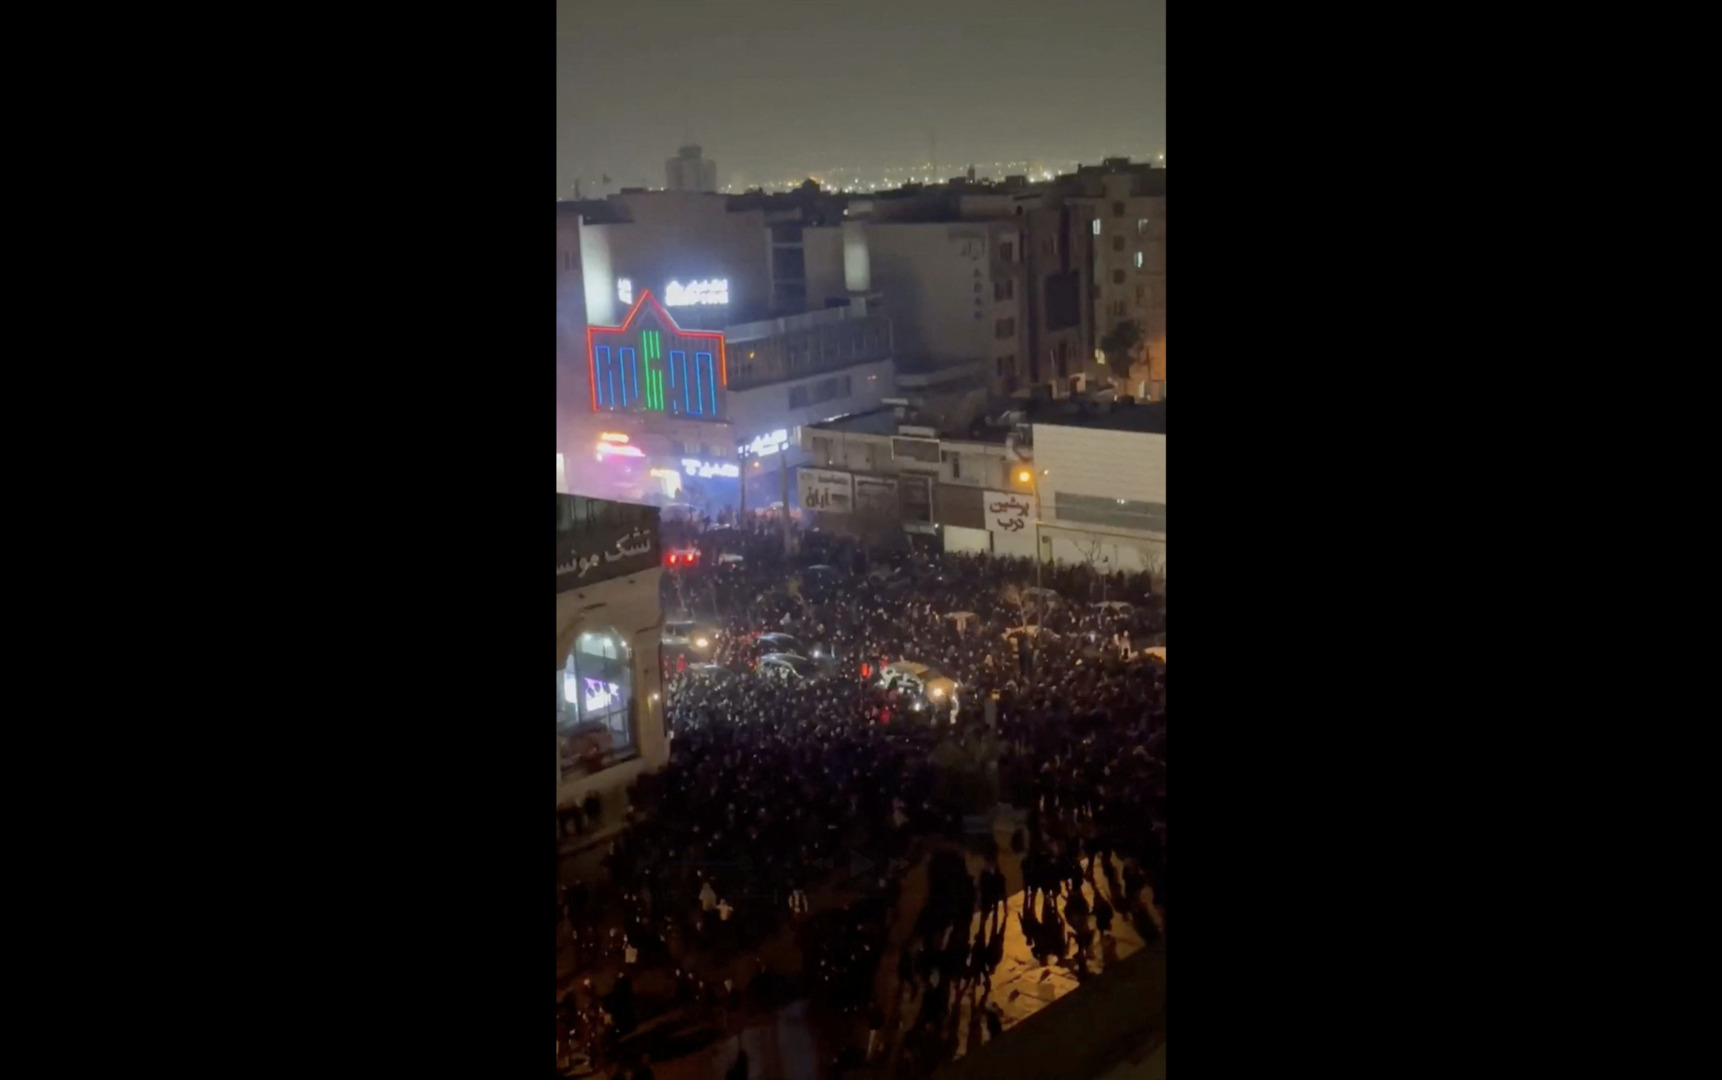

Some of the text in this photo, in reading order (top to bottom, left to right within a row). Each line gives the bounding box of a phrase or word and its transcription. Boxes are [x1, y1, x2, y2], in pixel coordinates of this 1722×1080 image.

[989, 496, 1030, 518] پرشین
[997, 517, 1025, 533] درب
[604, 526, 651, 562] تشک
